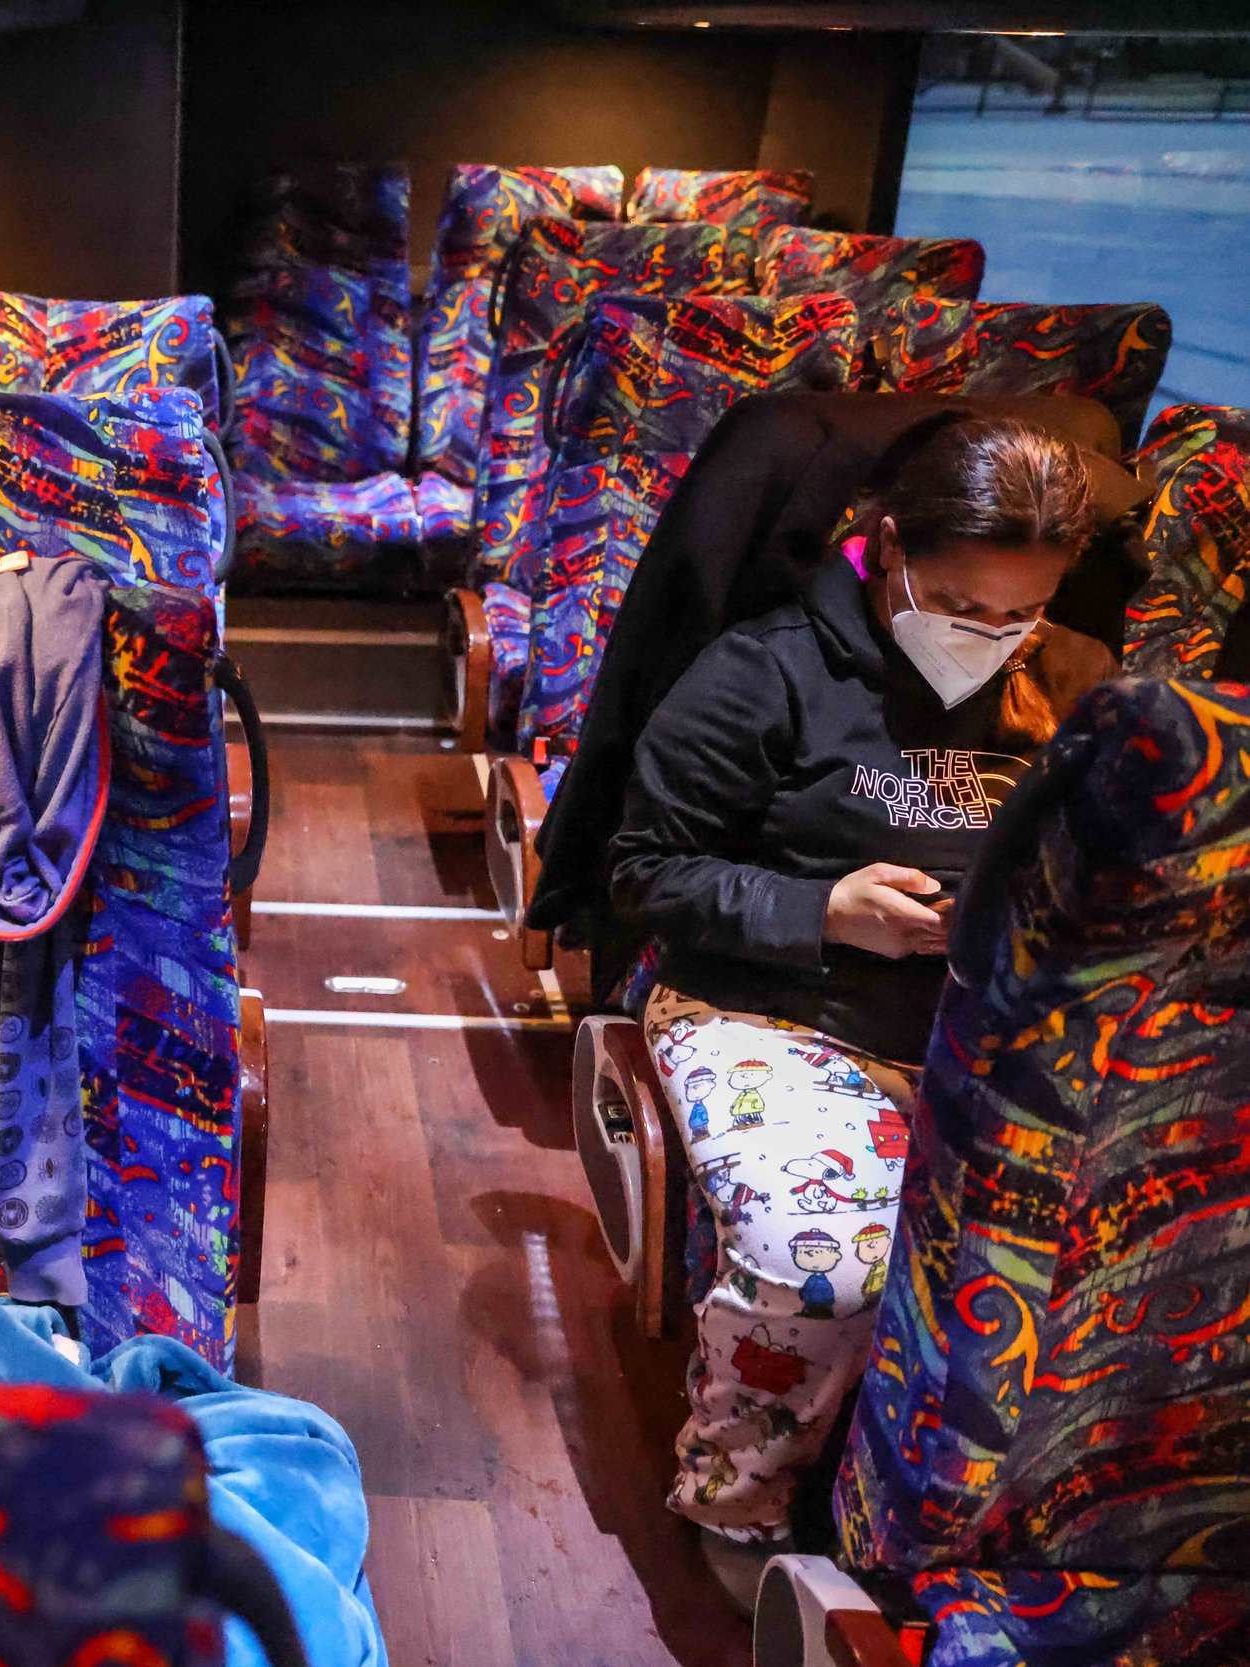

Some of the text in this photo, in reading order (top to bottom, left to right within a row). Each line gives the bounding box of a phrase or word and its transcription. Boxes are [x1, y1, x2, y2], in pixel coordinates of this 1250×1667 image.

[901, 749, 973, 780] THE
[850, 765, 982, 807] NORTH
[887, 801, 988, 829] FACE
